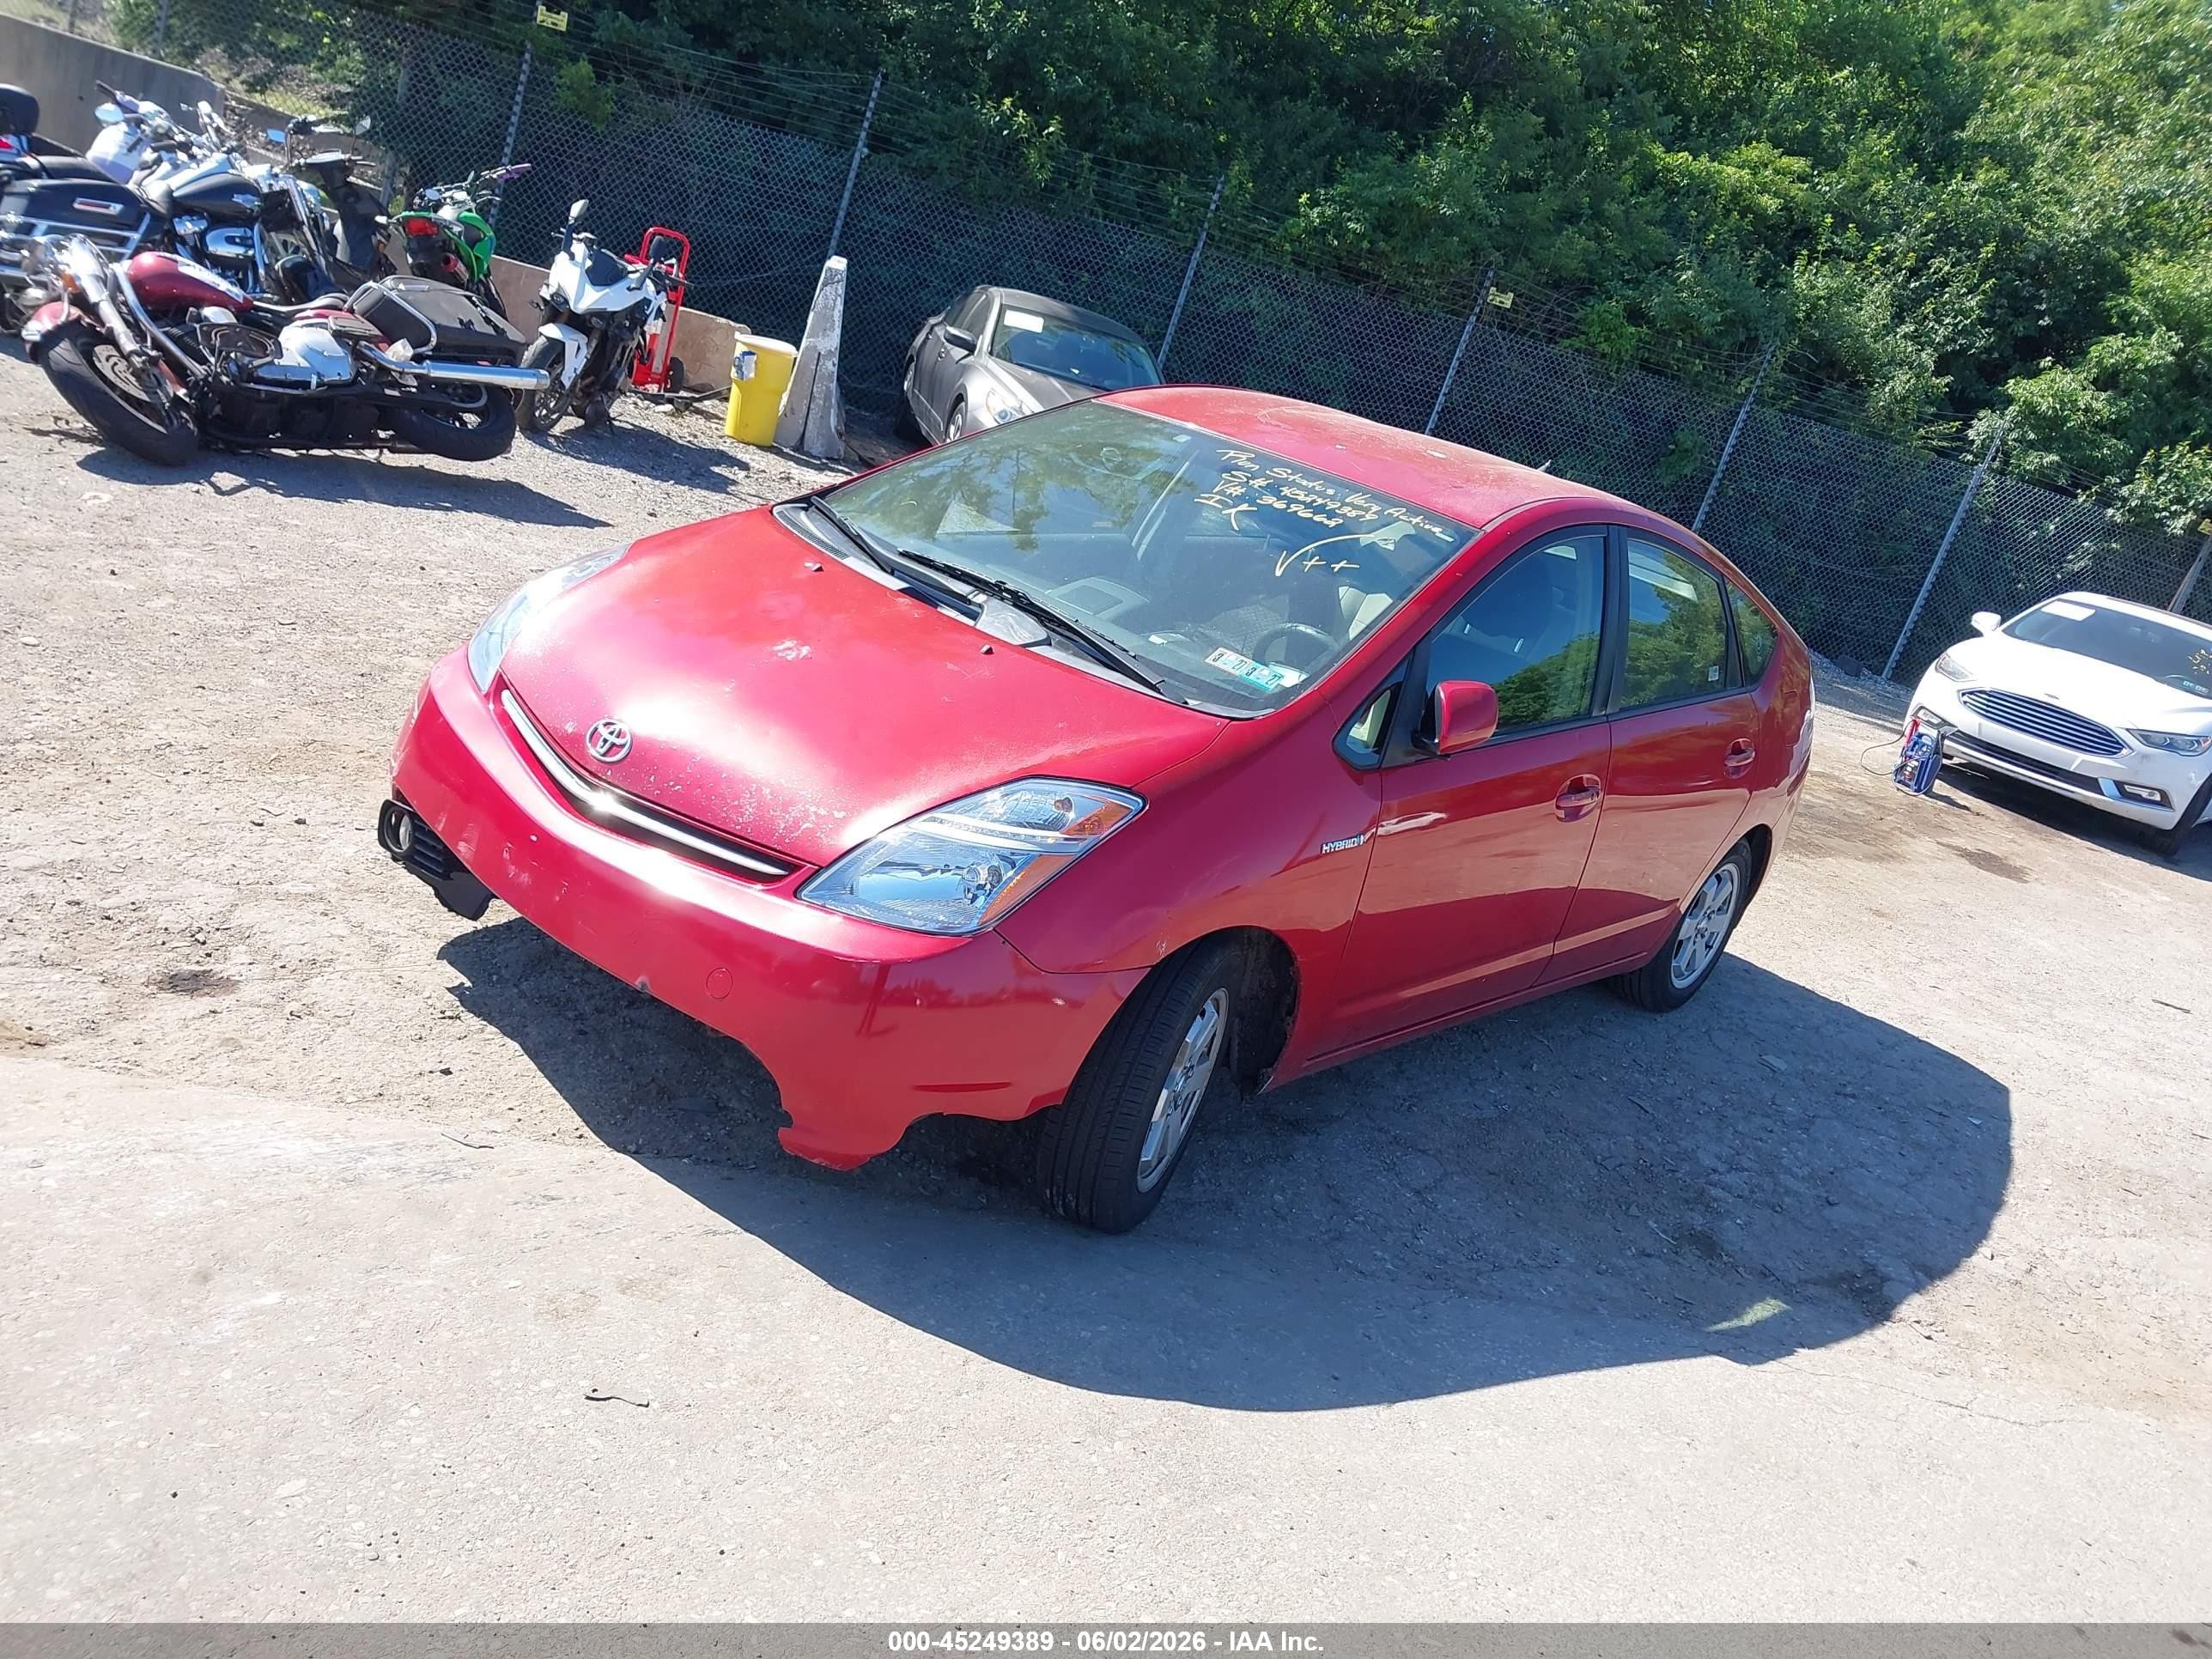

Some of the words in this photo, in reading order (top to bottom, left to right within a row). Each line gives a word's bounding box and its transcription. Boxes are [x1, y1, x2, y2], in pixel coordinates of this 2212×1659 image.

[1216, 449, 1260, 471] Run
[1345, 492, 1382, 513] Very
[1383, 507, 1444, 534] Active
[1279, 485, 1379, 521] 45249389
[1212, 653, 1224, 663] 3
[1231, 659, 1249, 671] 27
[1245, 666, 1257, 677] 3
[1265, 673, 1282, 686] 27
[1322, 837, 1358, 854] HYBRID
